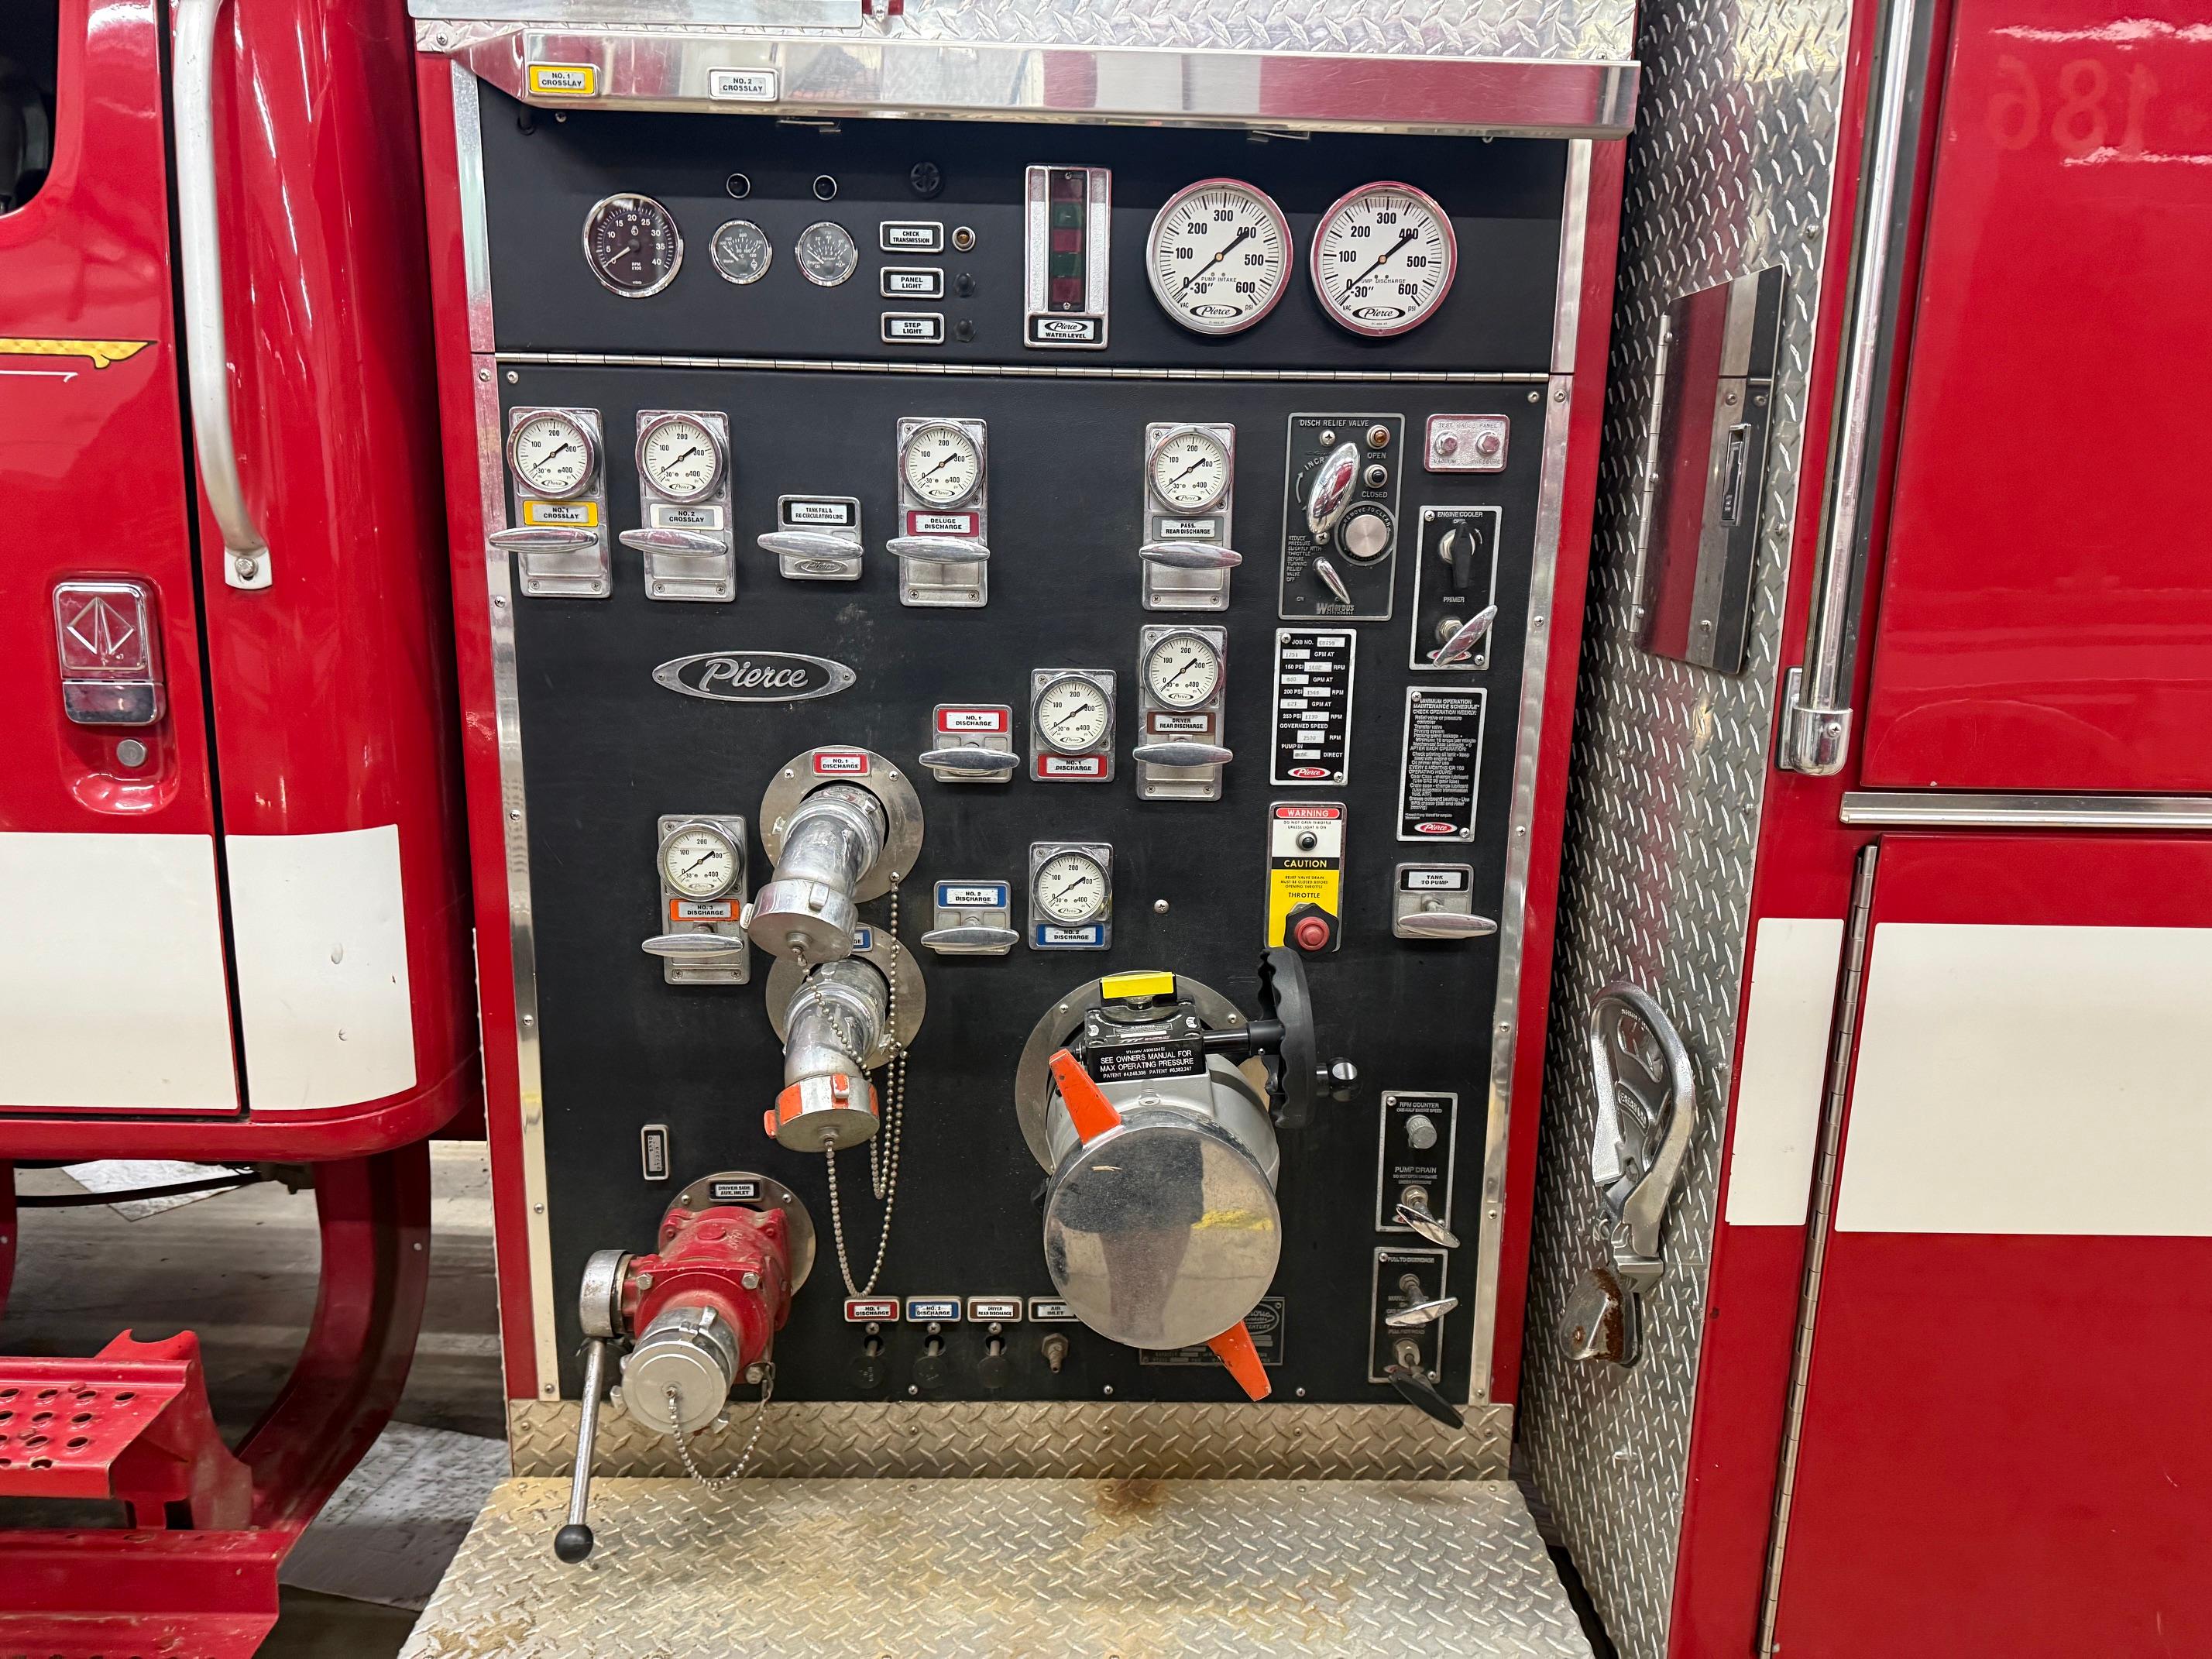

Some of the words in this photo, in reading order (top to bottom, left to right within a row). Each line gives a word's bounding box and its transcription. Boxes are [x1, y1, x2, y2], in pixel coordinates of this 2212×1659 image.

[1214, 210, 1233, 222] 300
[1377, 212, 1396, 224] 300
[1188, 223, 1207, 234] 200
[1351, 226, 1370, 237] 200
[1176, 248, 1193, 259] 100
[1339, 251, 1355, 262] 100
[1245, 254, 1263, 266] 500
[1407, 256, 1426, 267] 500
[1236, 282, 1255, 293] 600
[1398, 283, 1417, 295] 600
[1201, 307, 1231, 315] Pierce
[1364, 309, 1393, 318] Pierce
[1054, 323, 1077, 332] Pierce
[699, 658, 808, 692] Pierce
[1118, 1060, 1156, 1070] OPERATING
[1159, 1058, 1194, 1066] PRESSURE
